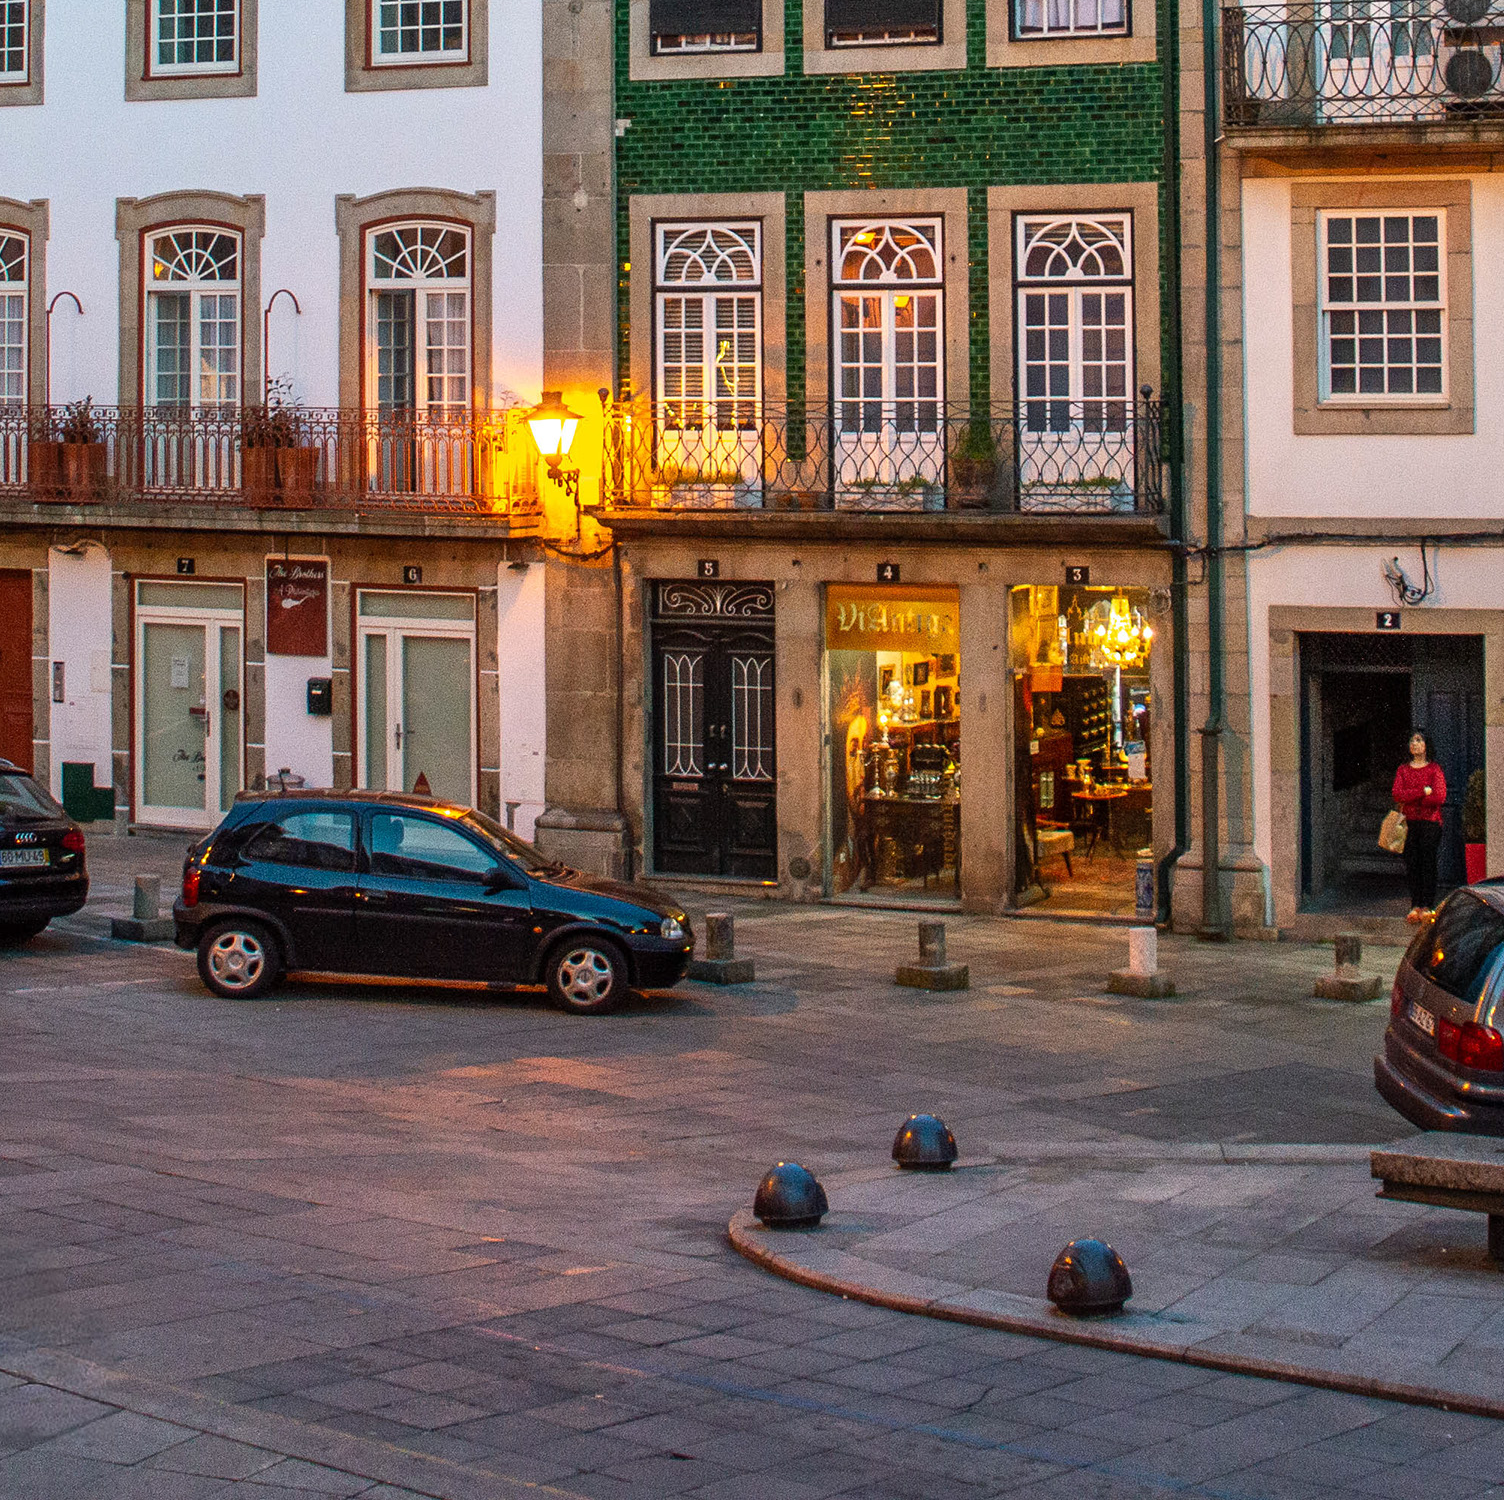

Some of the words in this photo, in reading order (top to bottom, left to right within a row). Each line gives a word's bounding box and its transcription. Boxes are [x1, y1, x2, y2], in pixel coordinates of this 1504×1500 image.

[181, 559, 189, 572] 7
[704, 562, 714, 576] 5
[883, 565, 893, 579] 4
[408, 567, 417, 581] 6
[1072, 568, 1082, 581] 3
[1383, 613, 1393, 627] 2
